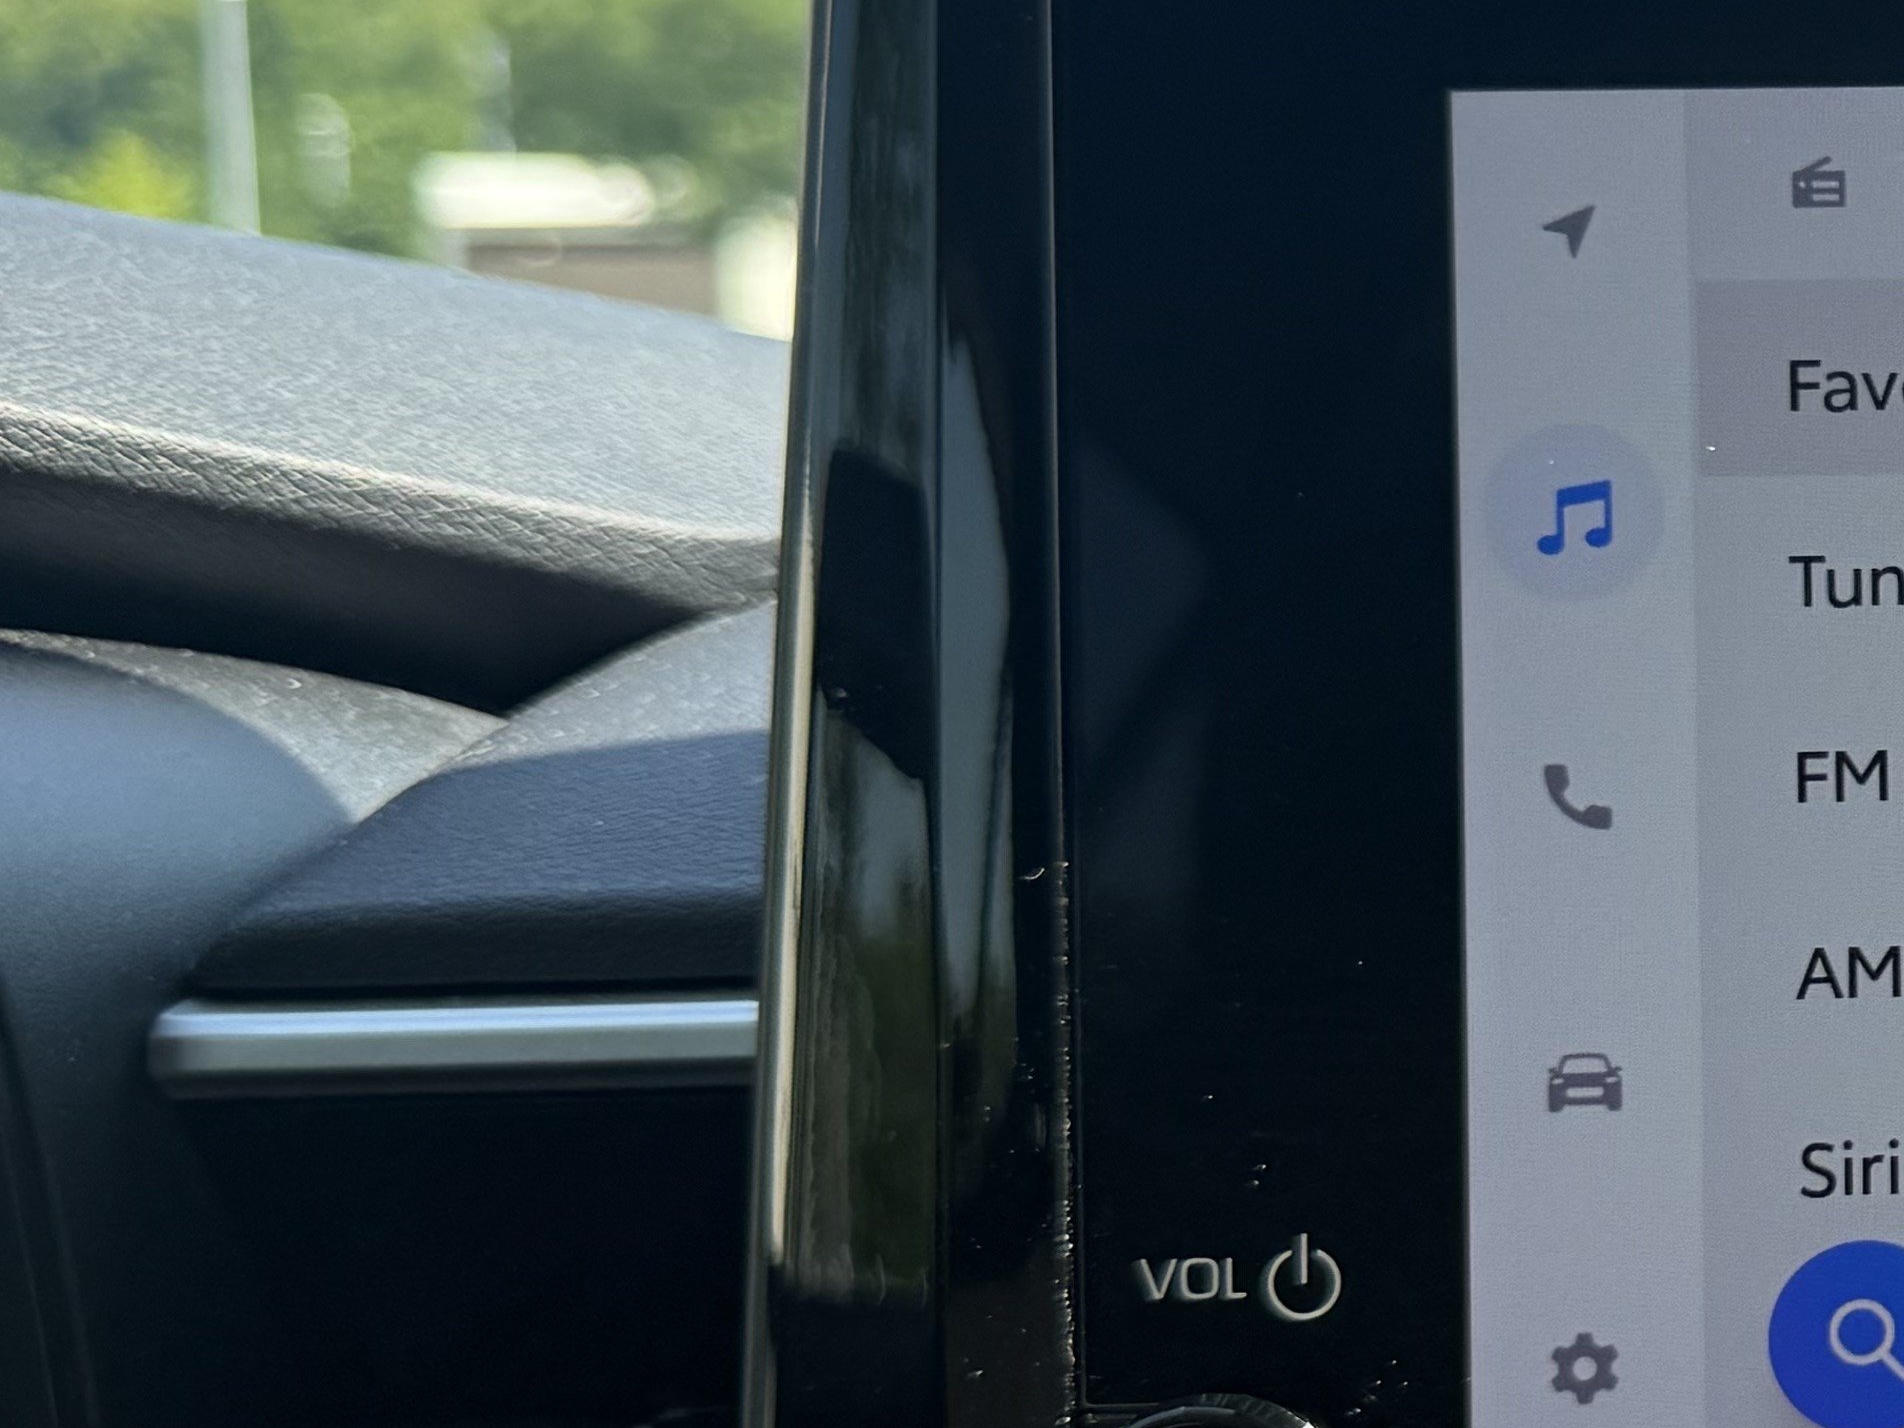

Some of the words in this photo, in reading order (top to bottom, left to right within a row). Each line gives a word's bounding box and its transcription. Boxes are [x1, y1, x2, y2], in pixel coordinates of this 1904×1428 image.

[1796, 749, 1889, 804] FM
[1795, 945, 1902, 1001] AM
[1138, 1256, 1248, 1301] VOL
